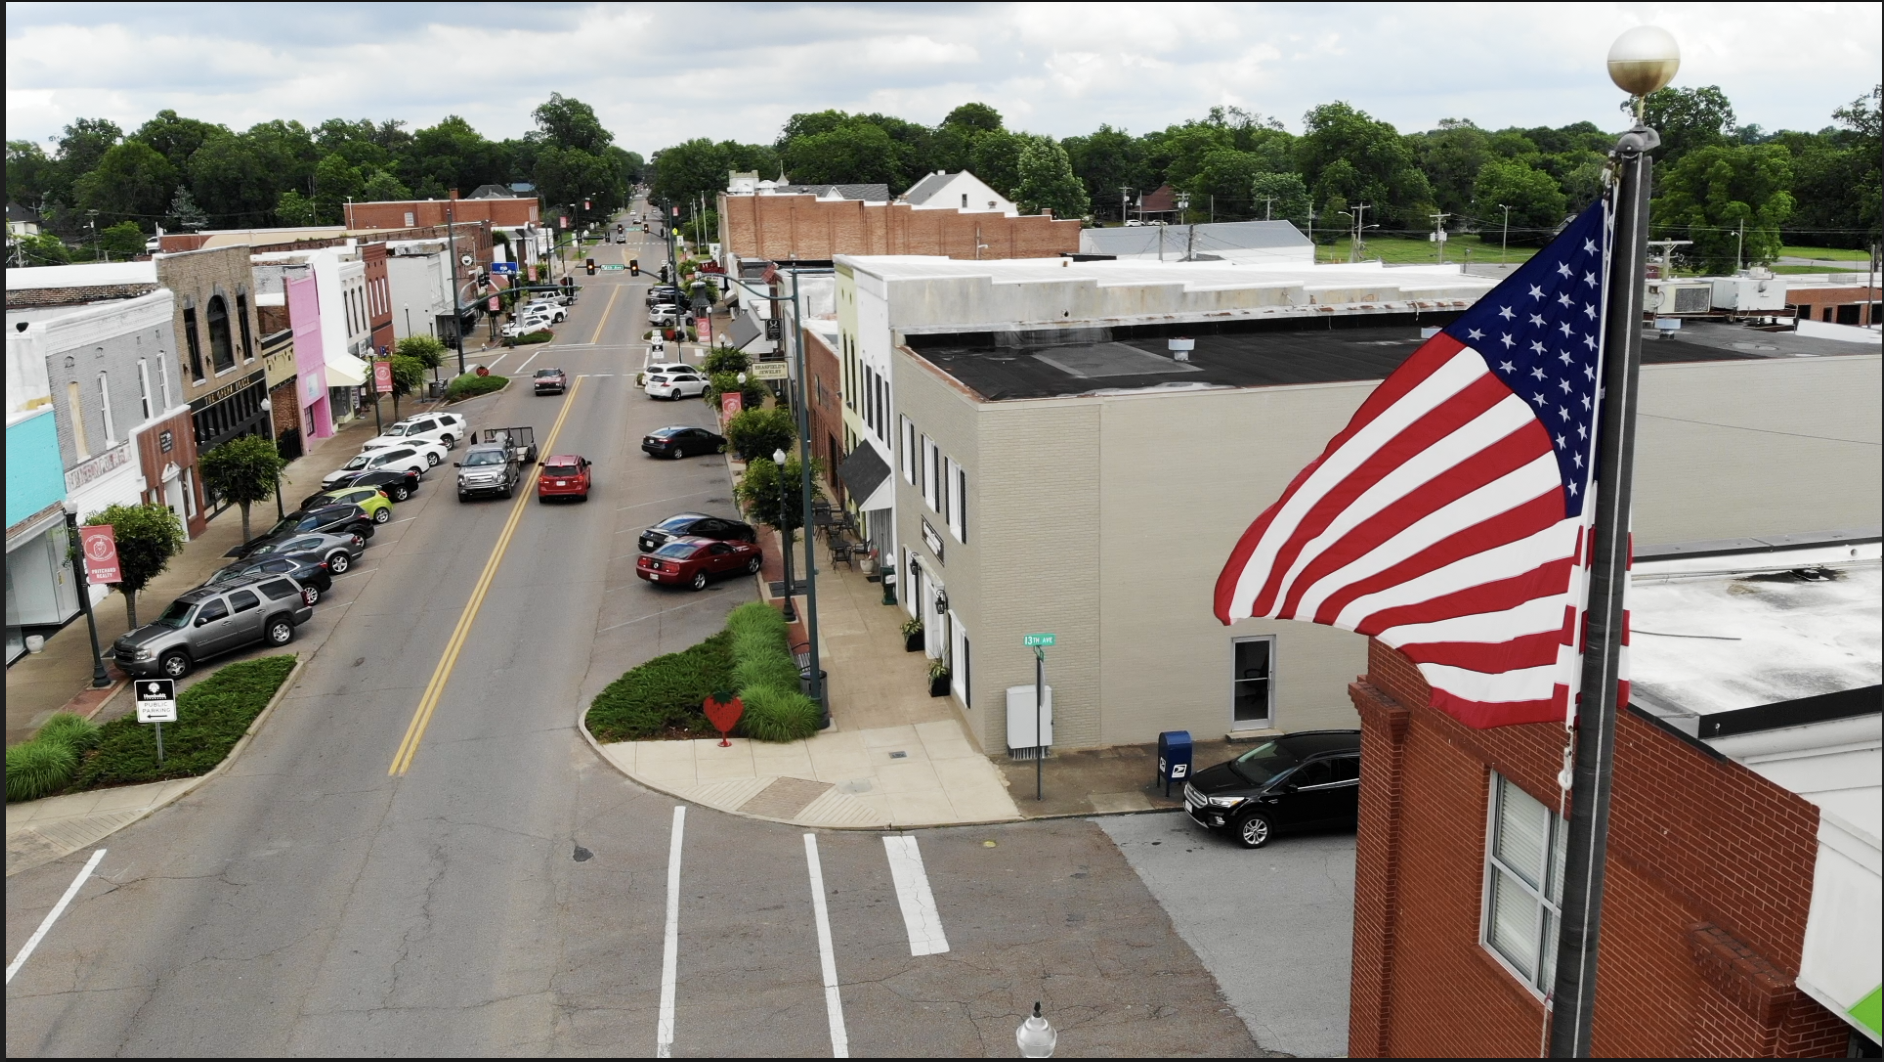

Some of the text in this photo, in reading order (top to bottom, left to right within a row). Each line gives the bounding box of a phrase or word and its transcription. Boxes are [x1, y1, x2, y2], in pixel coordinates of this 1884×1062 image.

[205, 394, 215, 406] THE
[217, 384, 233, 400] OPERA
[1024, 635, 1040, 645] 13TH
